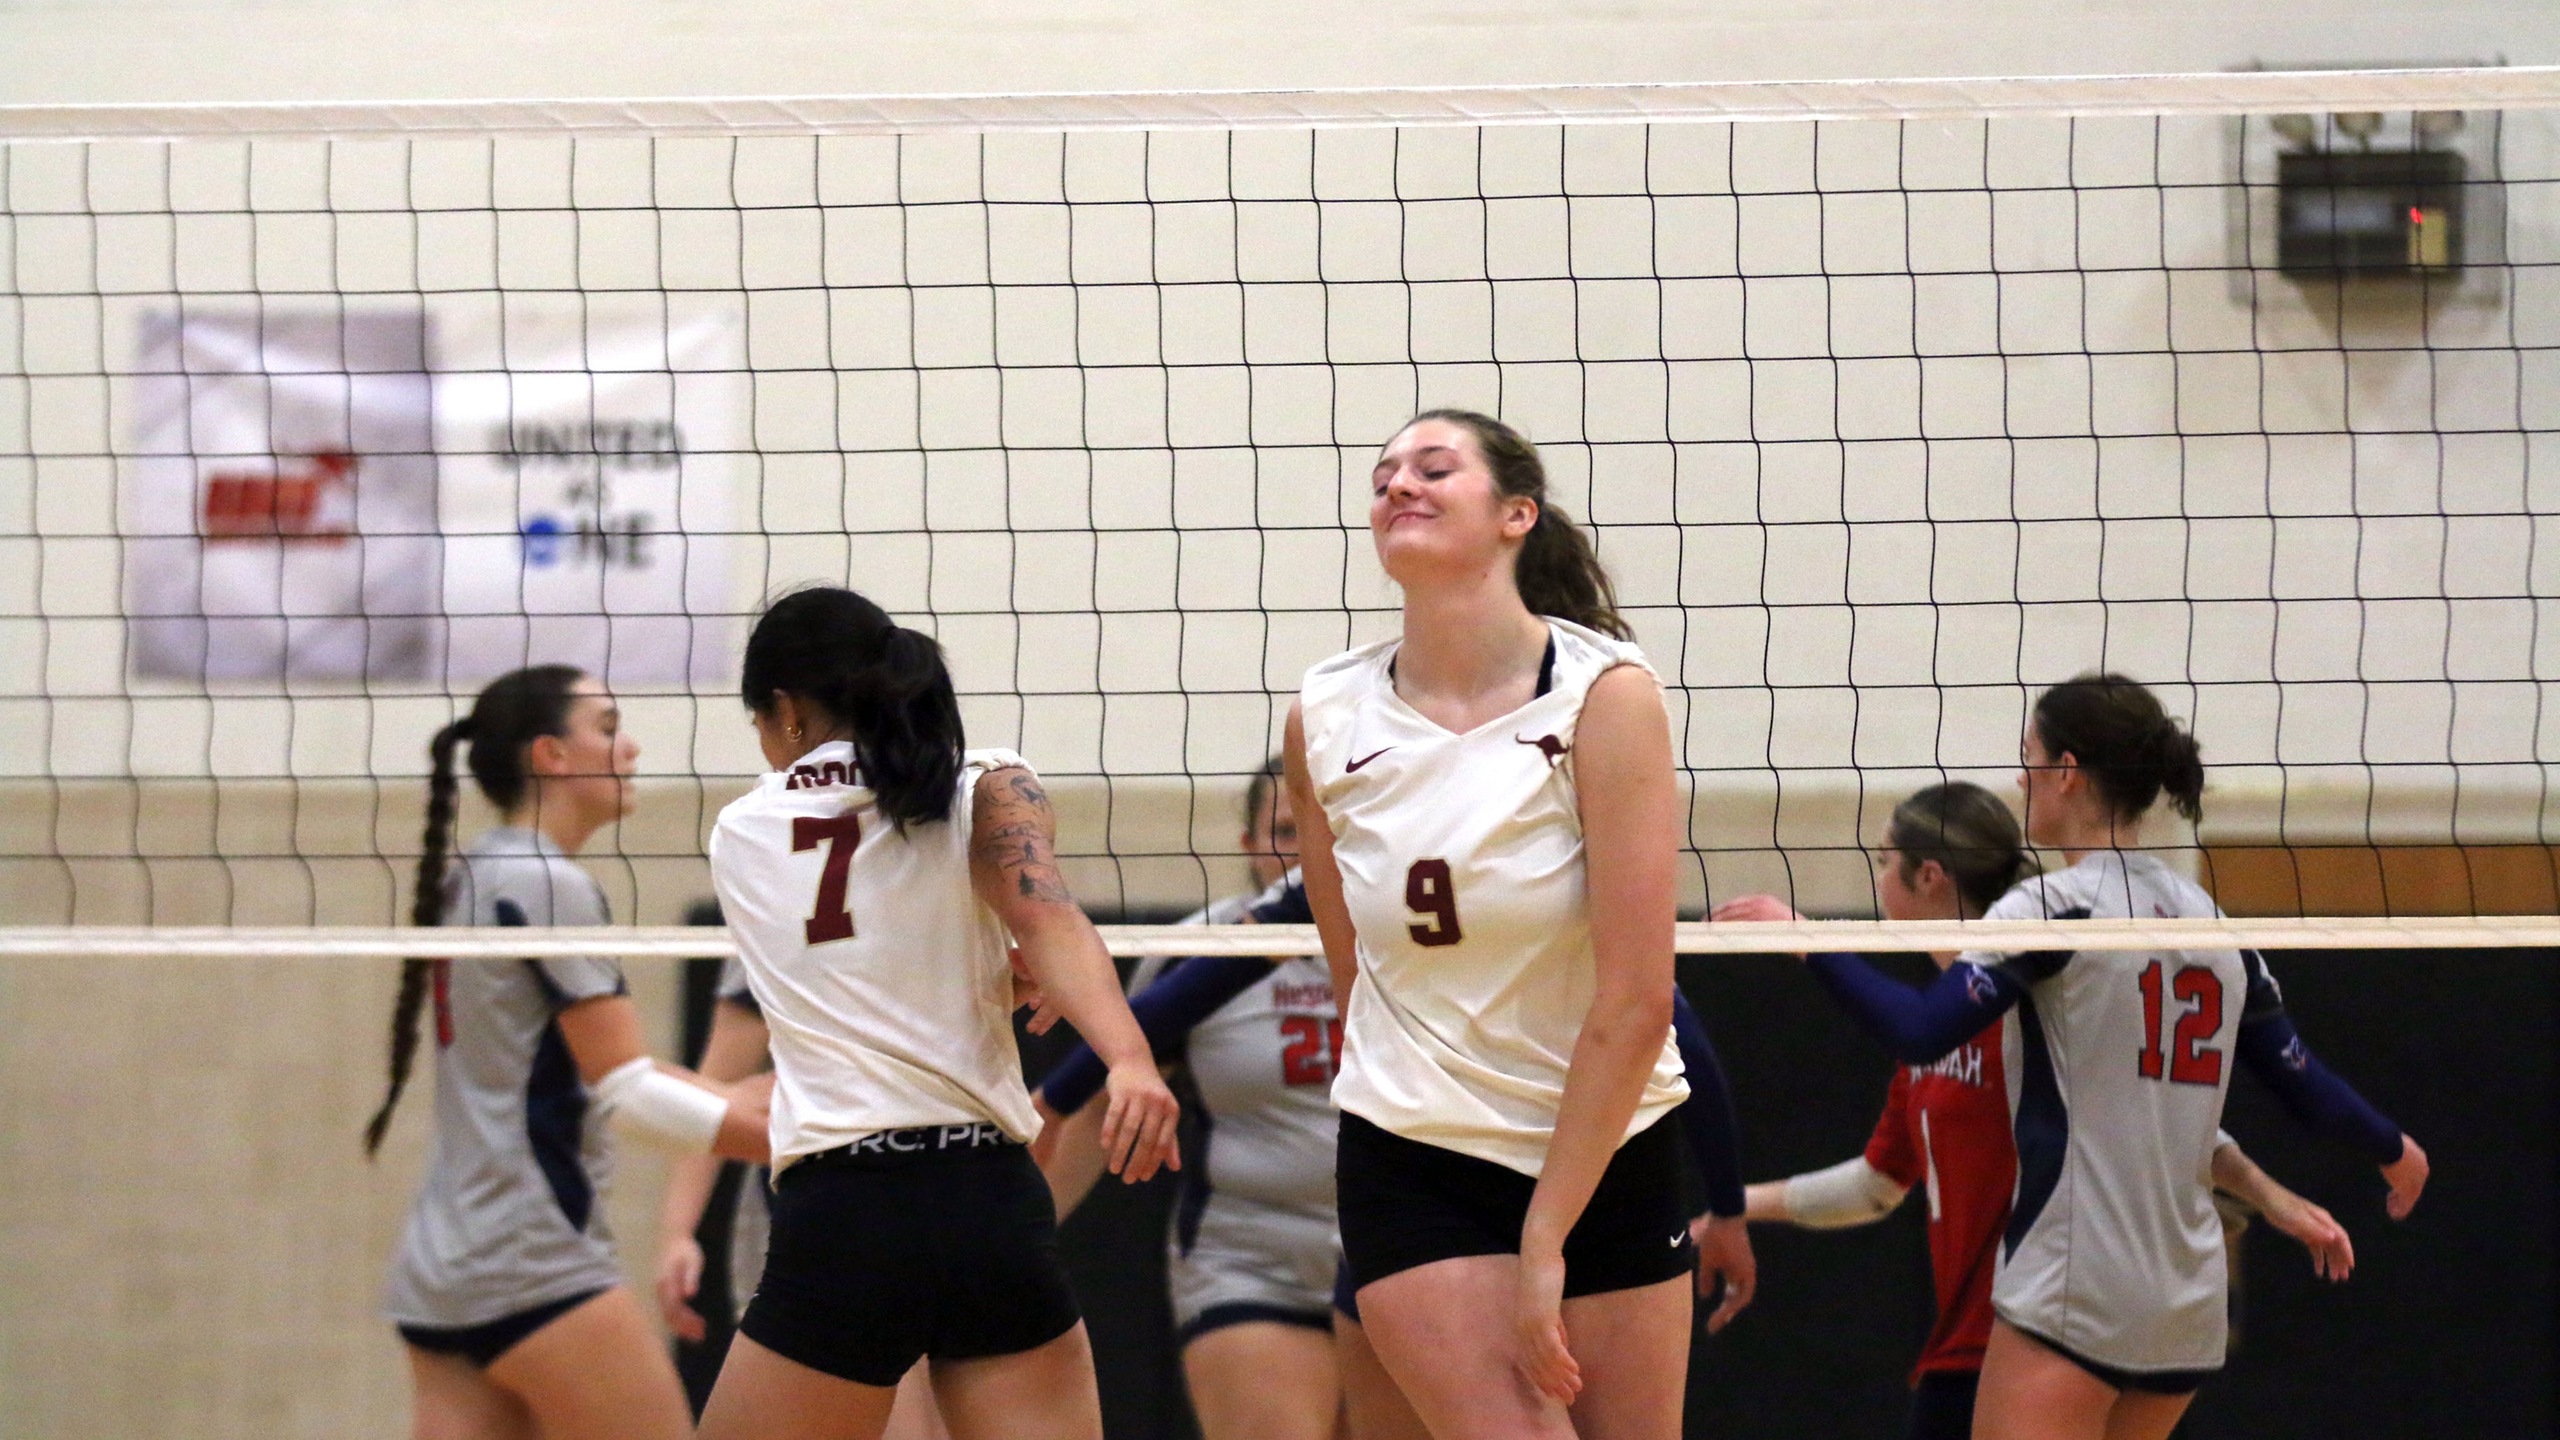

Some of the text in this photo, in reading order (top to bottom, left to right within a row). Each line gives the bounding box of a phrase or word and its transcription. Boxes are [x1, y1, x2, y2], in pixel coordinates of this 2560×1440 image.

[790, 813, 862, 947] 7
[1404, 856, 1464, 948] 9
[2138, 958, 2223, 1087] 12
[937, 1124, 1013, 1149] PR
